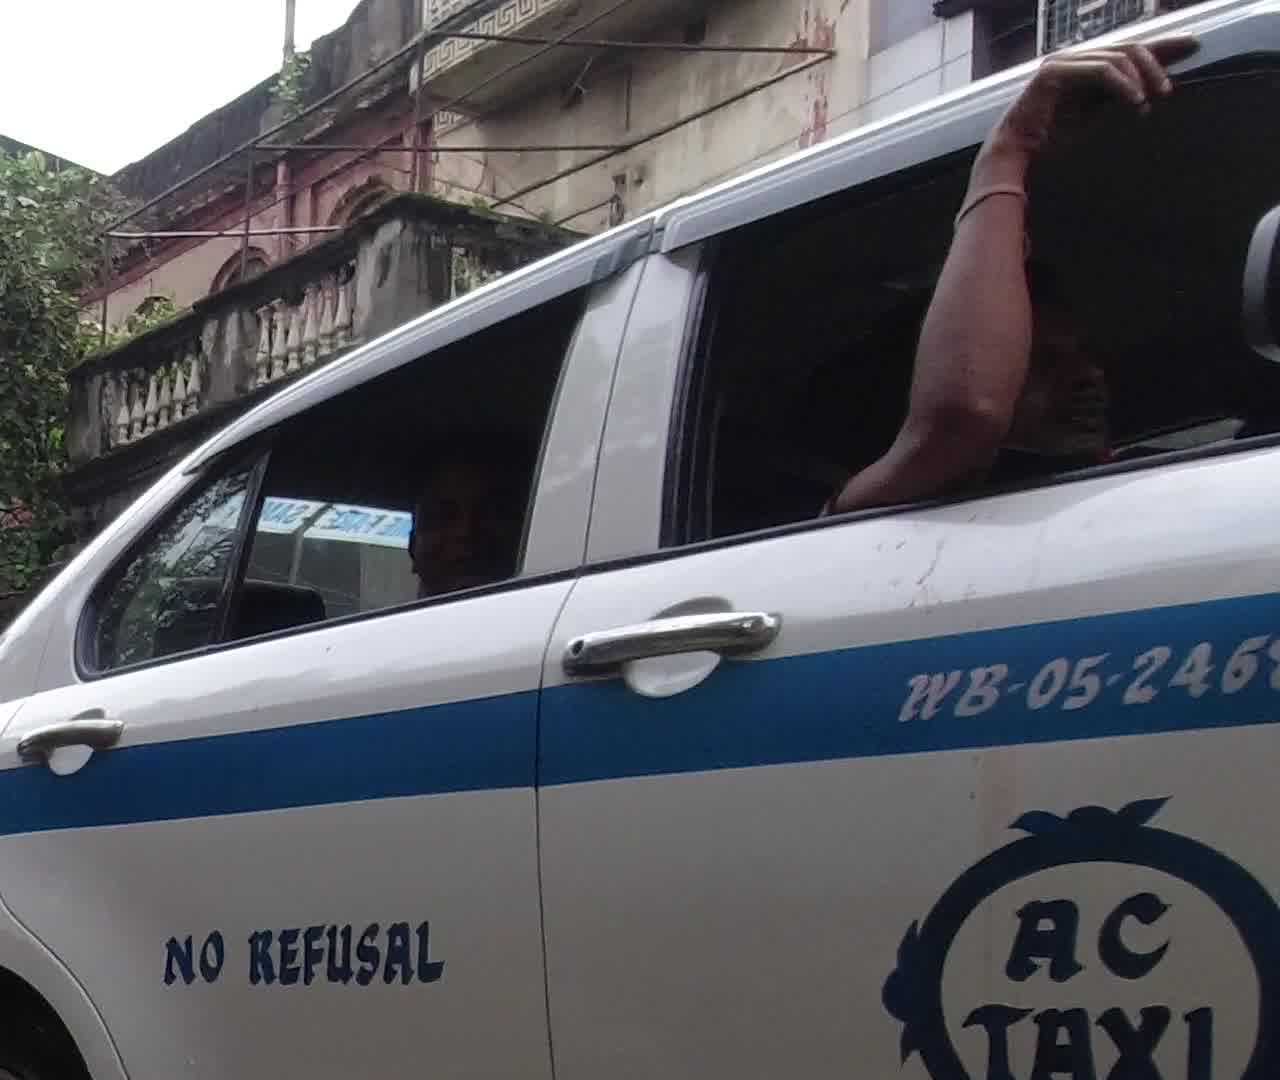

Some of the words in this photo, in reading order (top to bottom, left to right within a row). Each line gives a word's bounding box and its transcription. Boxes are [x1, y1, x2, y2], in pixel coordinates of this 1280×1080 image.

[163, 929, 225, 986] NO
[247, 920, 446, 987] REFUSAL
[1005, 892, 1173, 983] AC
